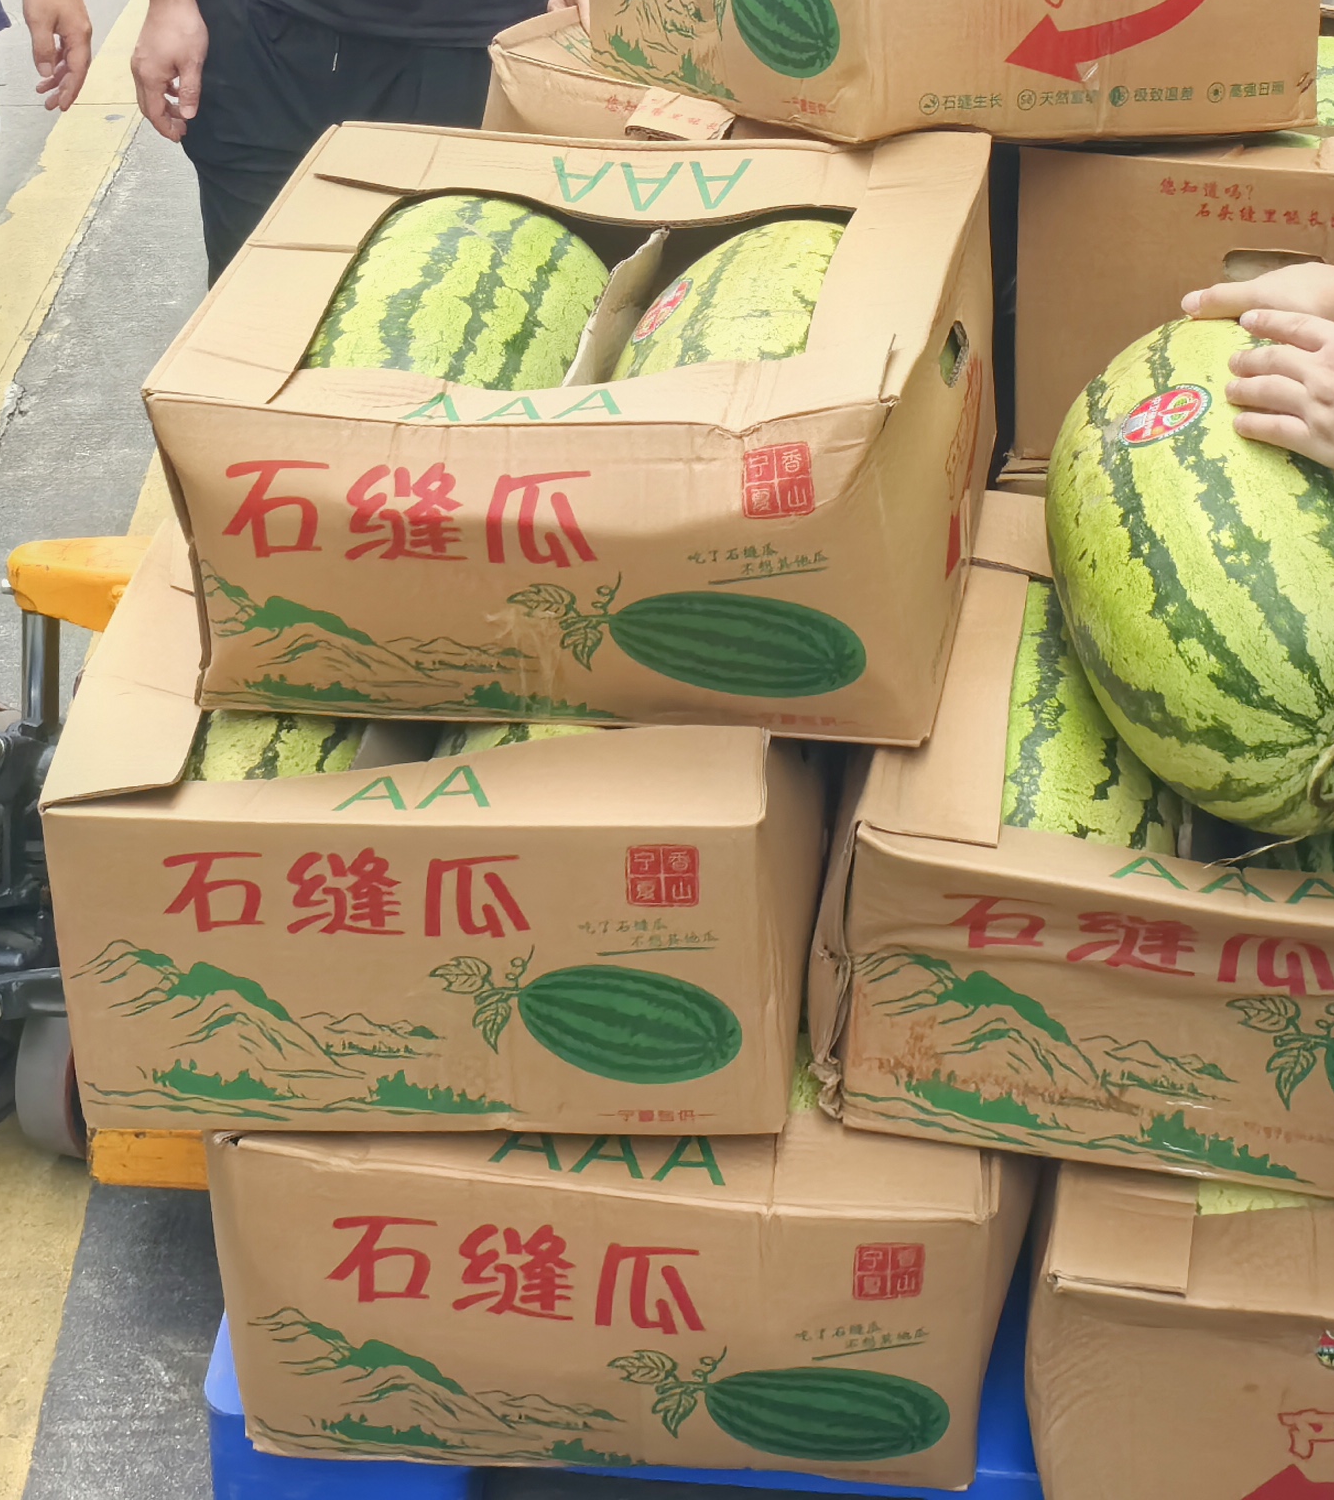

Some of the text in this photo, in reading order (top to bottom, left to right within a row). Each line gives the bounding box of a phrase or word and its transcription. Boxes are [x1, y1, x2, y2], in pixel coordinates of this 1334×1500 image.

[396, 388, 624, 423] AAA
[222, 460, 599, 570] 石缝瓜
[331, 764, 492, 812] AA
[162, 847, 531, 939] 石缝瓜
[489, 1135, 727, 1187] AAA
[327, 1215, 706, 1335] 石缝瓜
